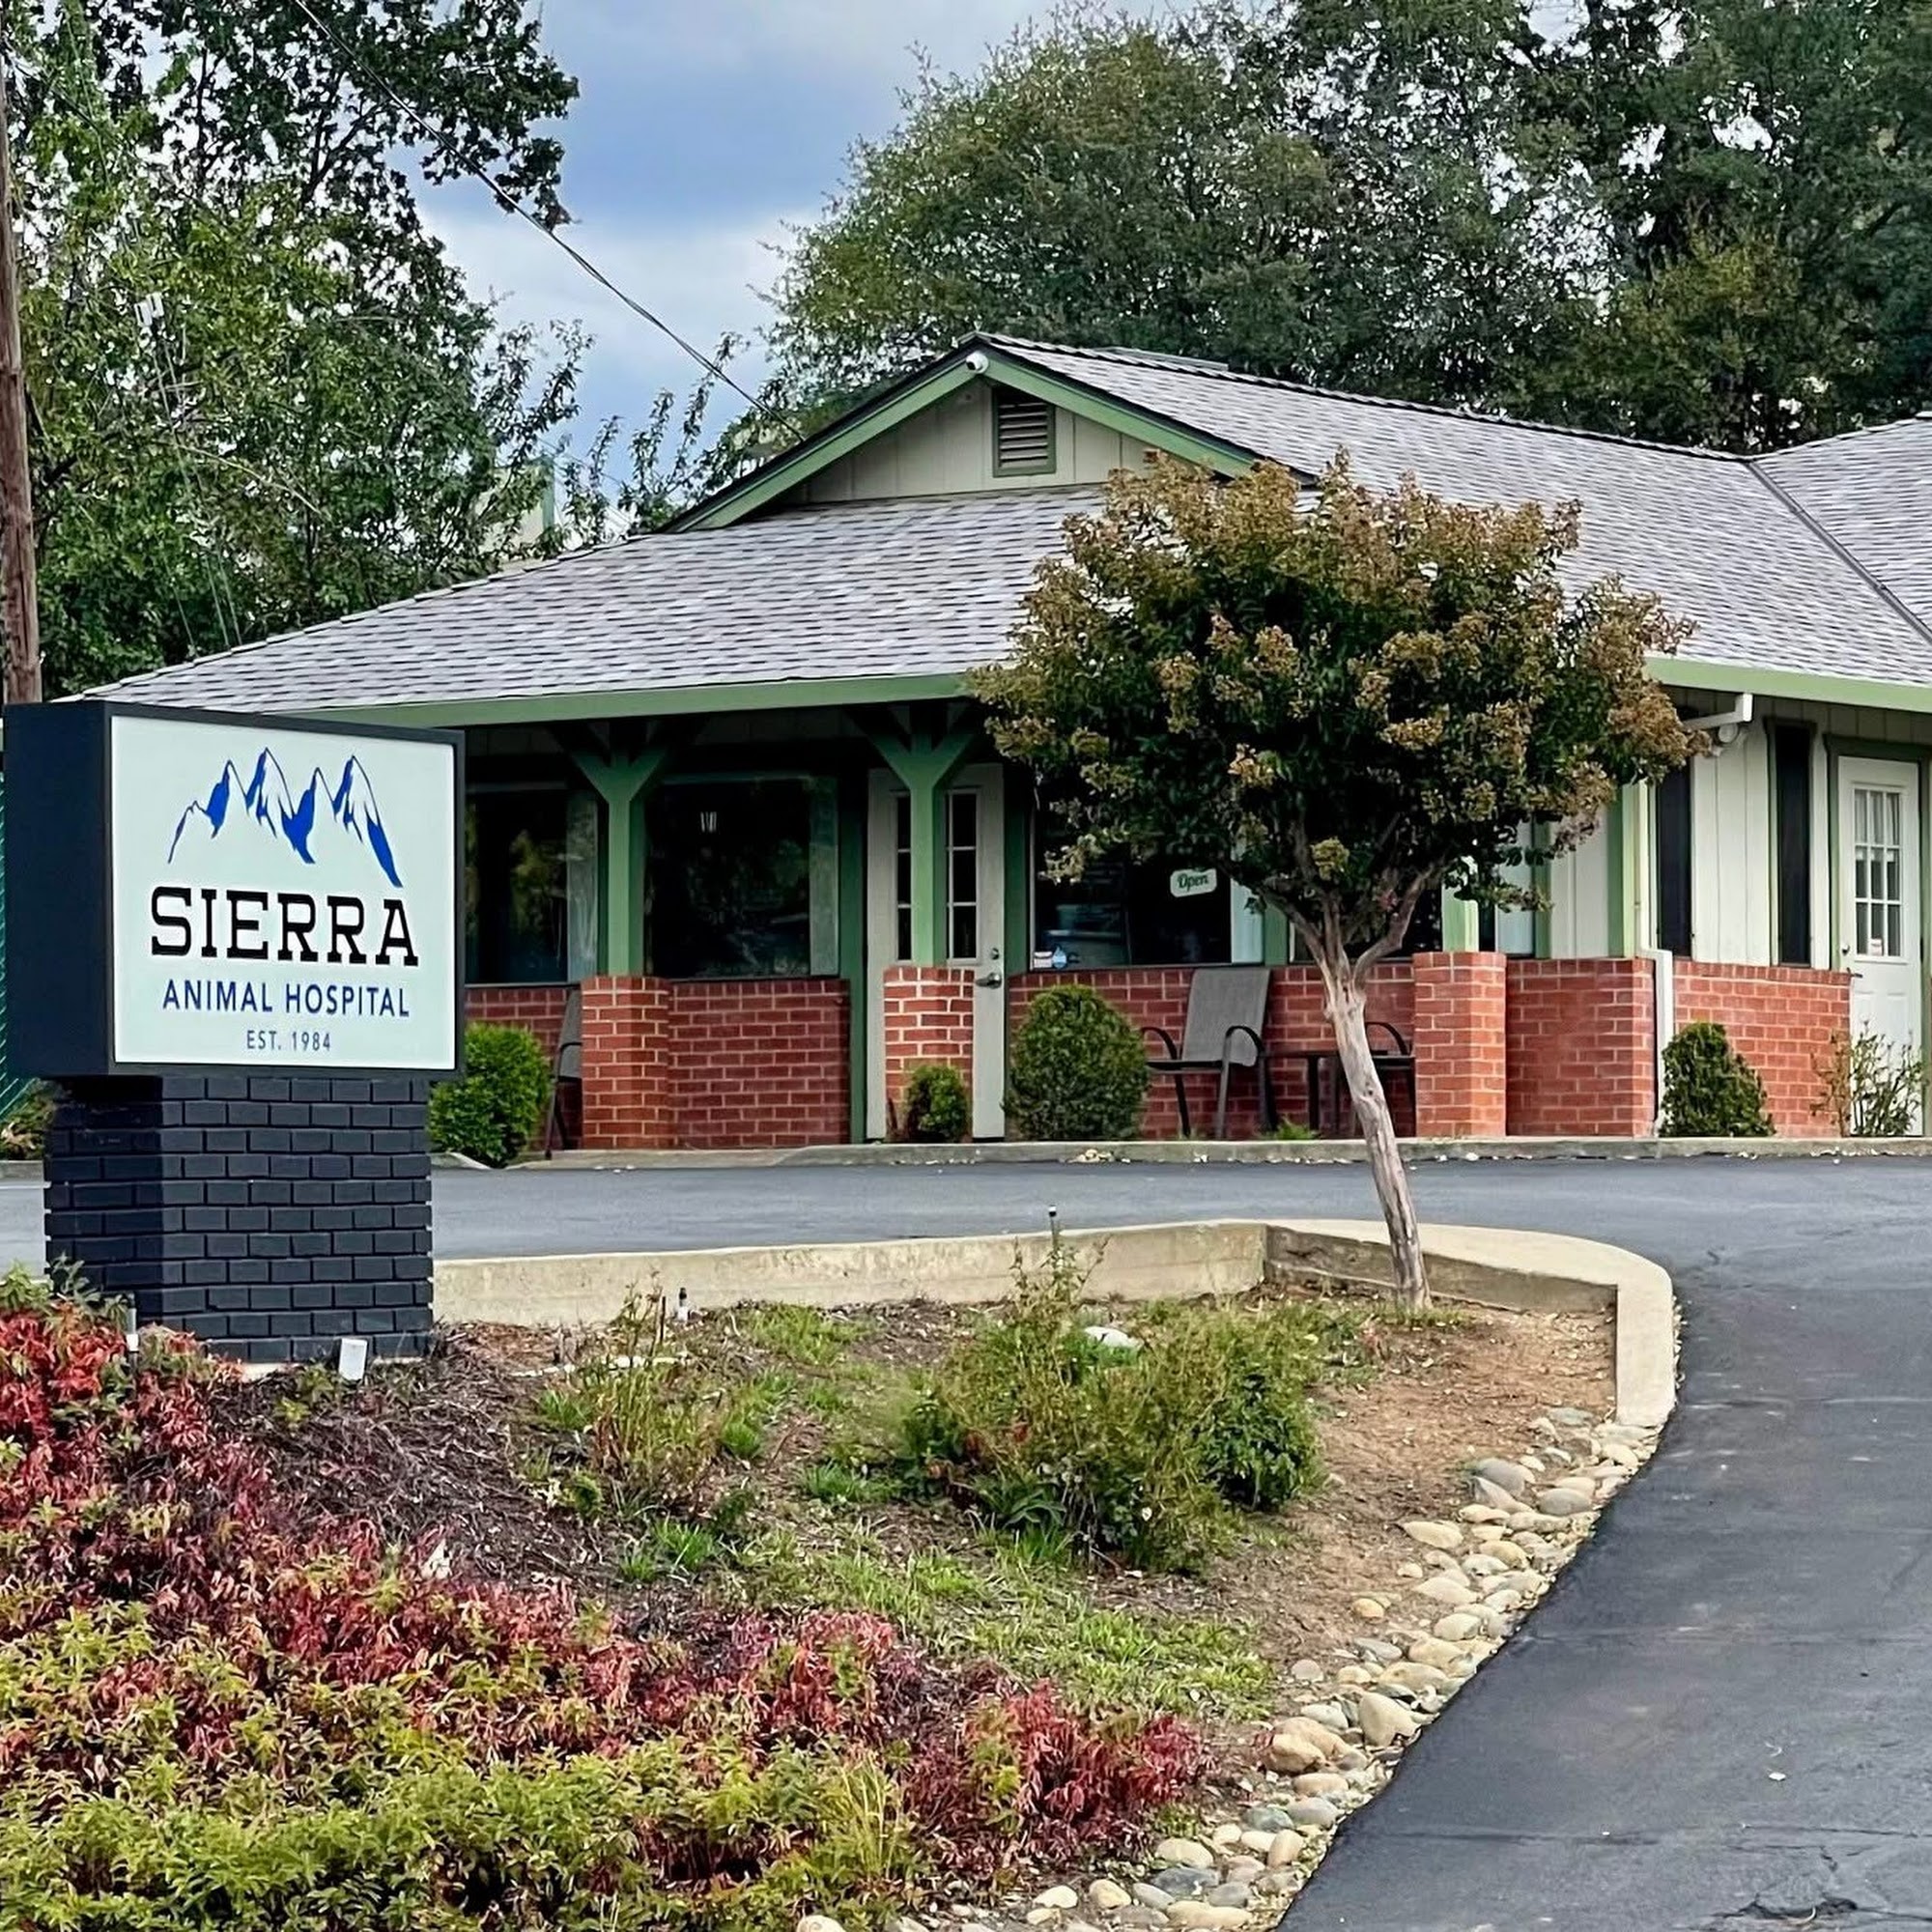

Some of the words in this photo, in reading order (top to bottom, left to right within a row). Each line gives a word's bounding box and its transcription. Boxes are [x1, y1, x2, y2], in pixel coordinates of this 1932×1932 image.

[1177, 872, 1209, 892] Open
[152, 886, 418, 966] SIERRA
[162, 979, 272, 1012] ANIMAL
[286, 983, 410, 1017] HOSPITAL
[246, 1030, 281, 1050] EST.
[292, 1032, 331, 1051] 1984
